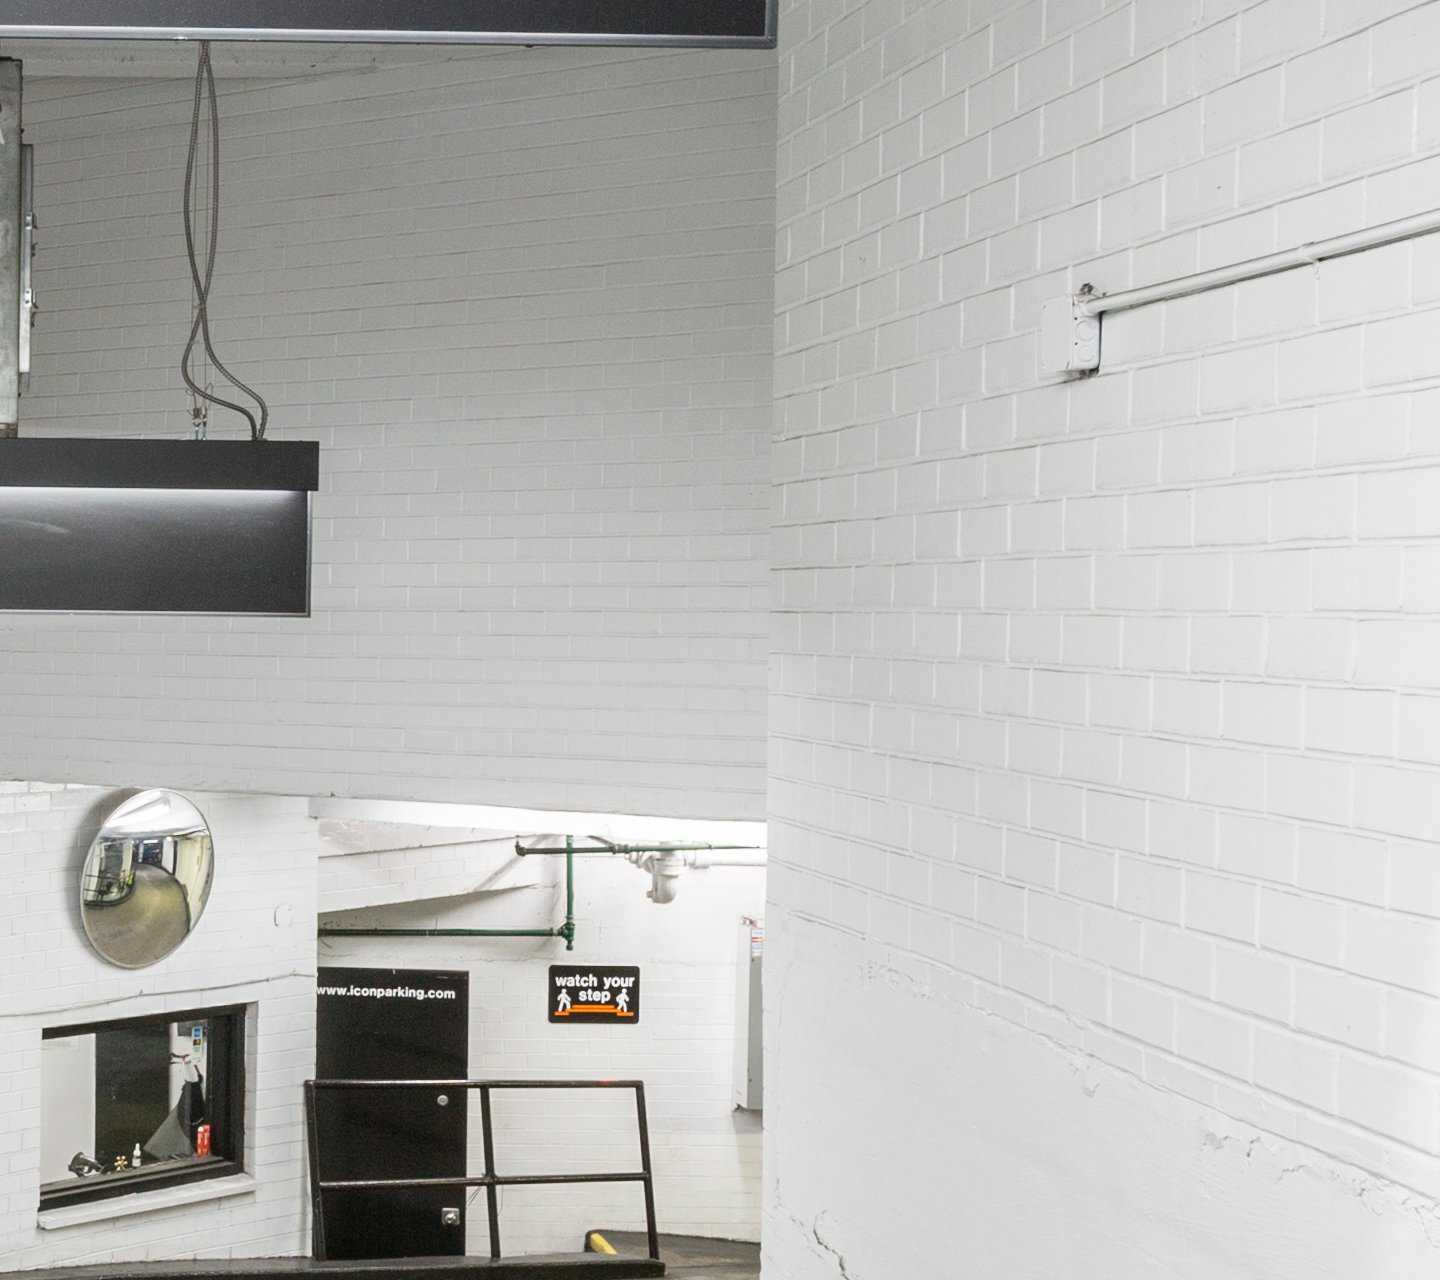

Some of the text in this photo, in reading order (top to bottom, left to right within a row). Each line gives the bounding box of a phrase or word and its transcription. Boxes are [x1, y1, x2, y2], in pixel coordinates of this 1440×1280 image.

[555, 973, 635, 991] watch your
[316, 984, 456, 1001] www.iconparking.com
[578, 988, 611, 1004] step
